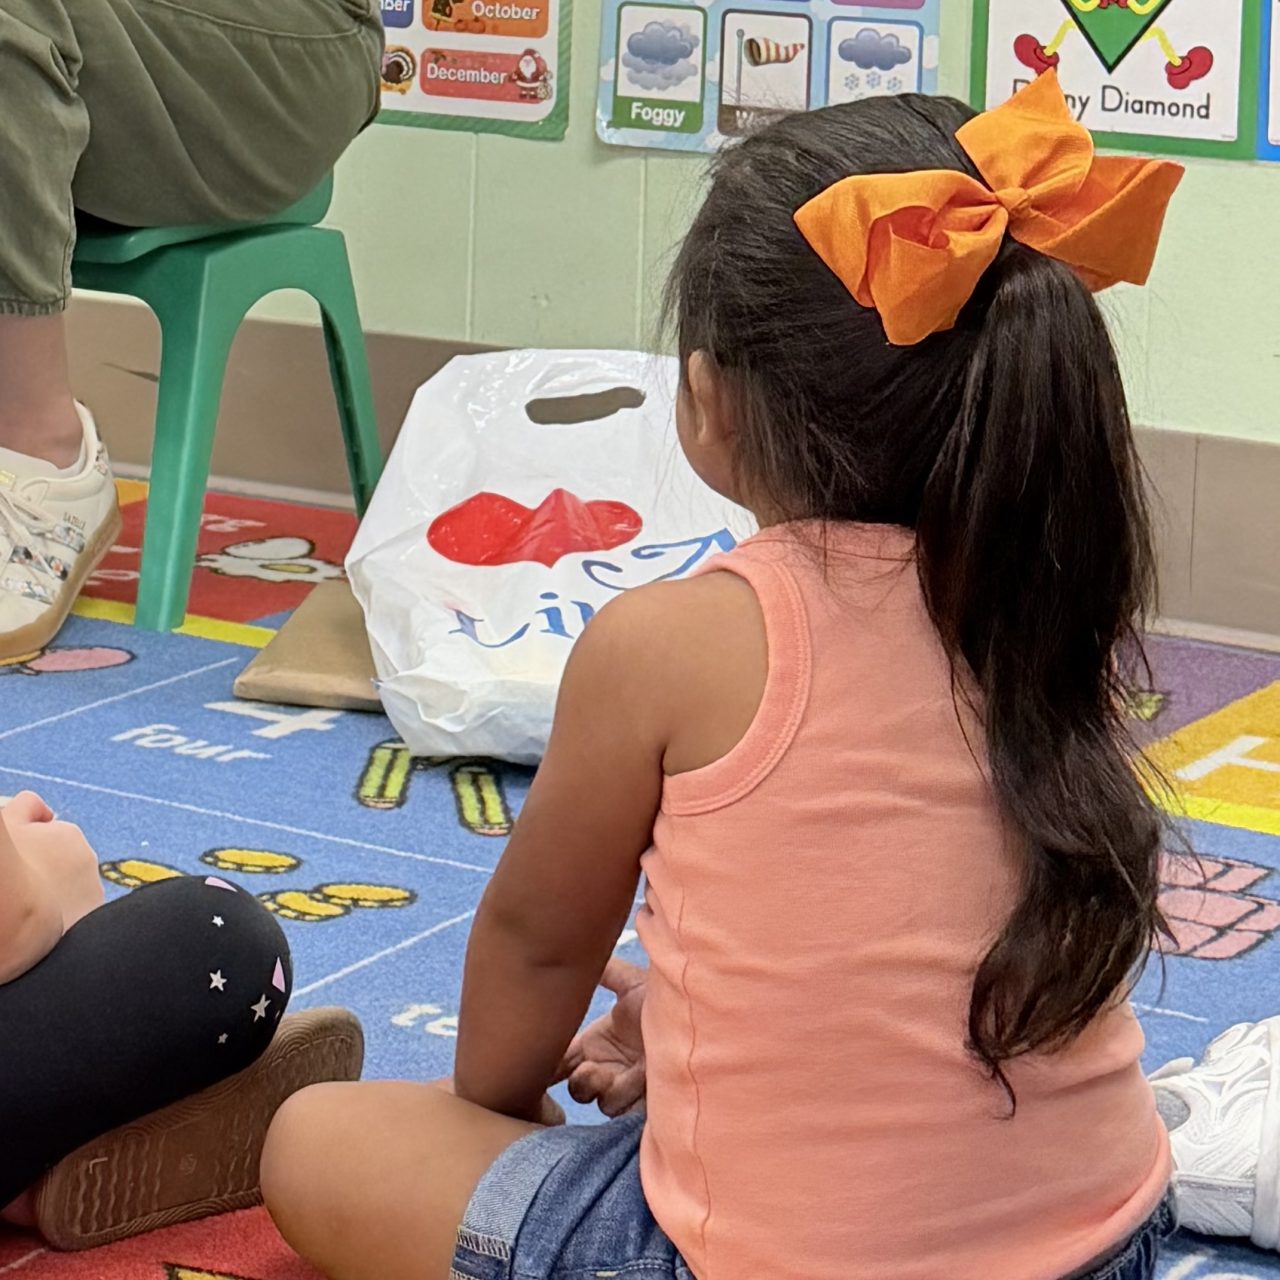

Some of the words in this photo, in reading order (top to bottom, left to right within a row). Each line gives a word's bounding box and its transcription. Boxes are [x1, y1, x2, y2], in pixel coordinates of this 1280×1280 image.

[472, 0, 540, 20] October
[427, 64, 508, 85] December
[631, 102, 686, 128] Foggy
[1101, 85, 1211, 120] Diamond
[111, 723, 273, 763] four
